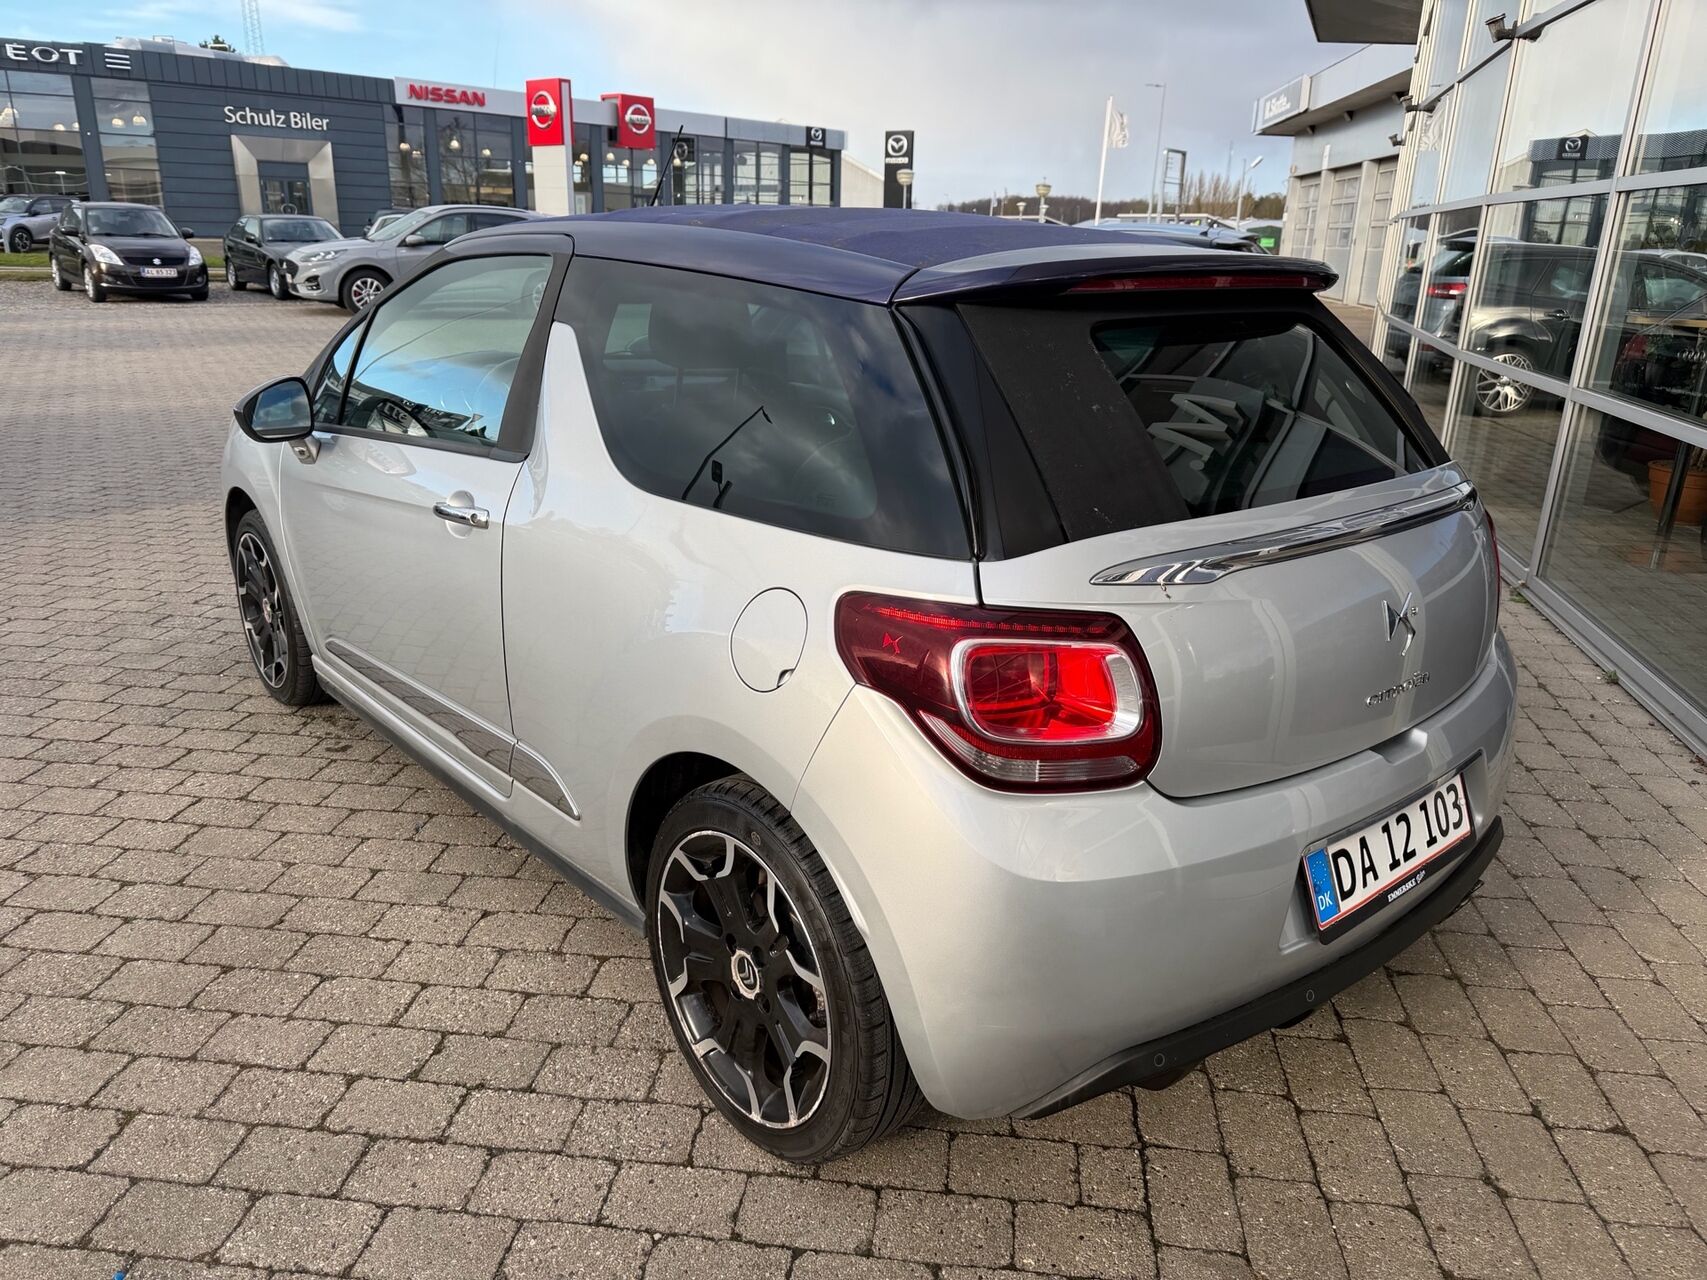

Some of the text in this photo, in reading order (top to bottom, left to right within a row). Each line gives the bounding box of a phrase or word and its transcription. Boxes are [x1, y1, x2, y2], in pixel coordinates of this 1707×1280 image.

[408, 83, 486, 107] NISSAN
[223, 105, 330, 131] Schulz Biler
[1331, 783, 1463, 902] DA 12 103
[1318, 890, 1332, 911] DK
